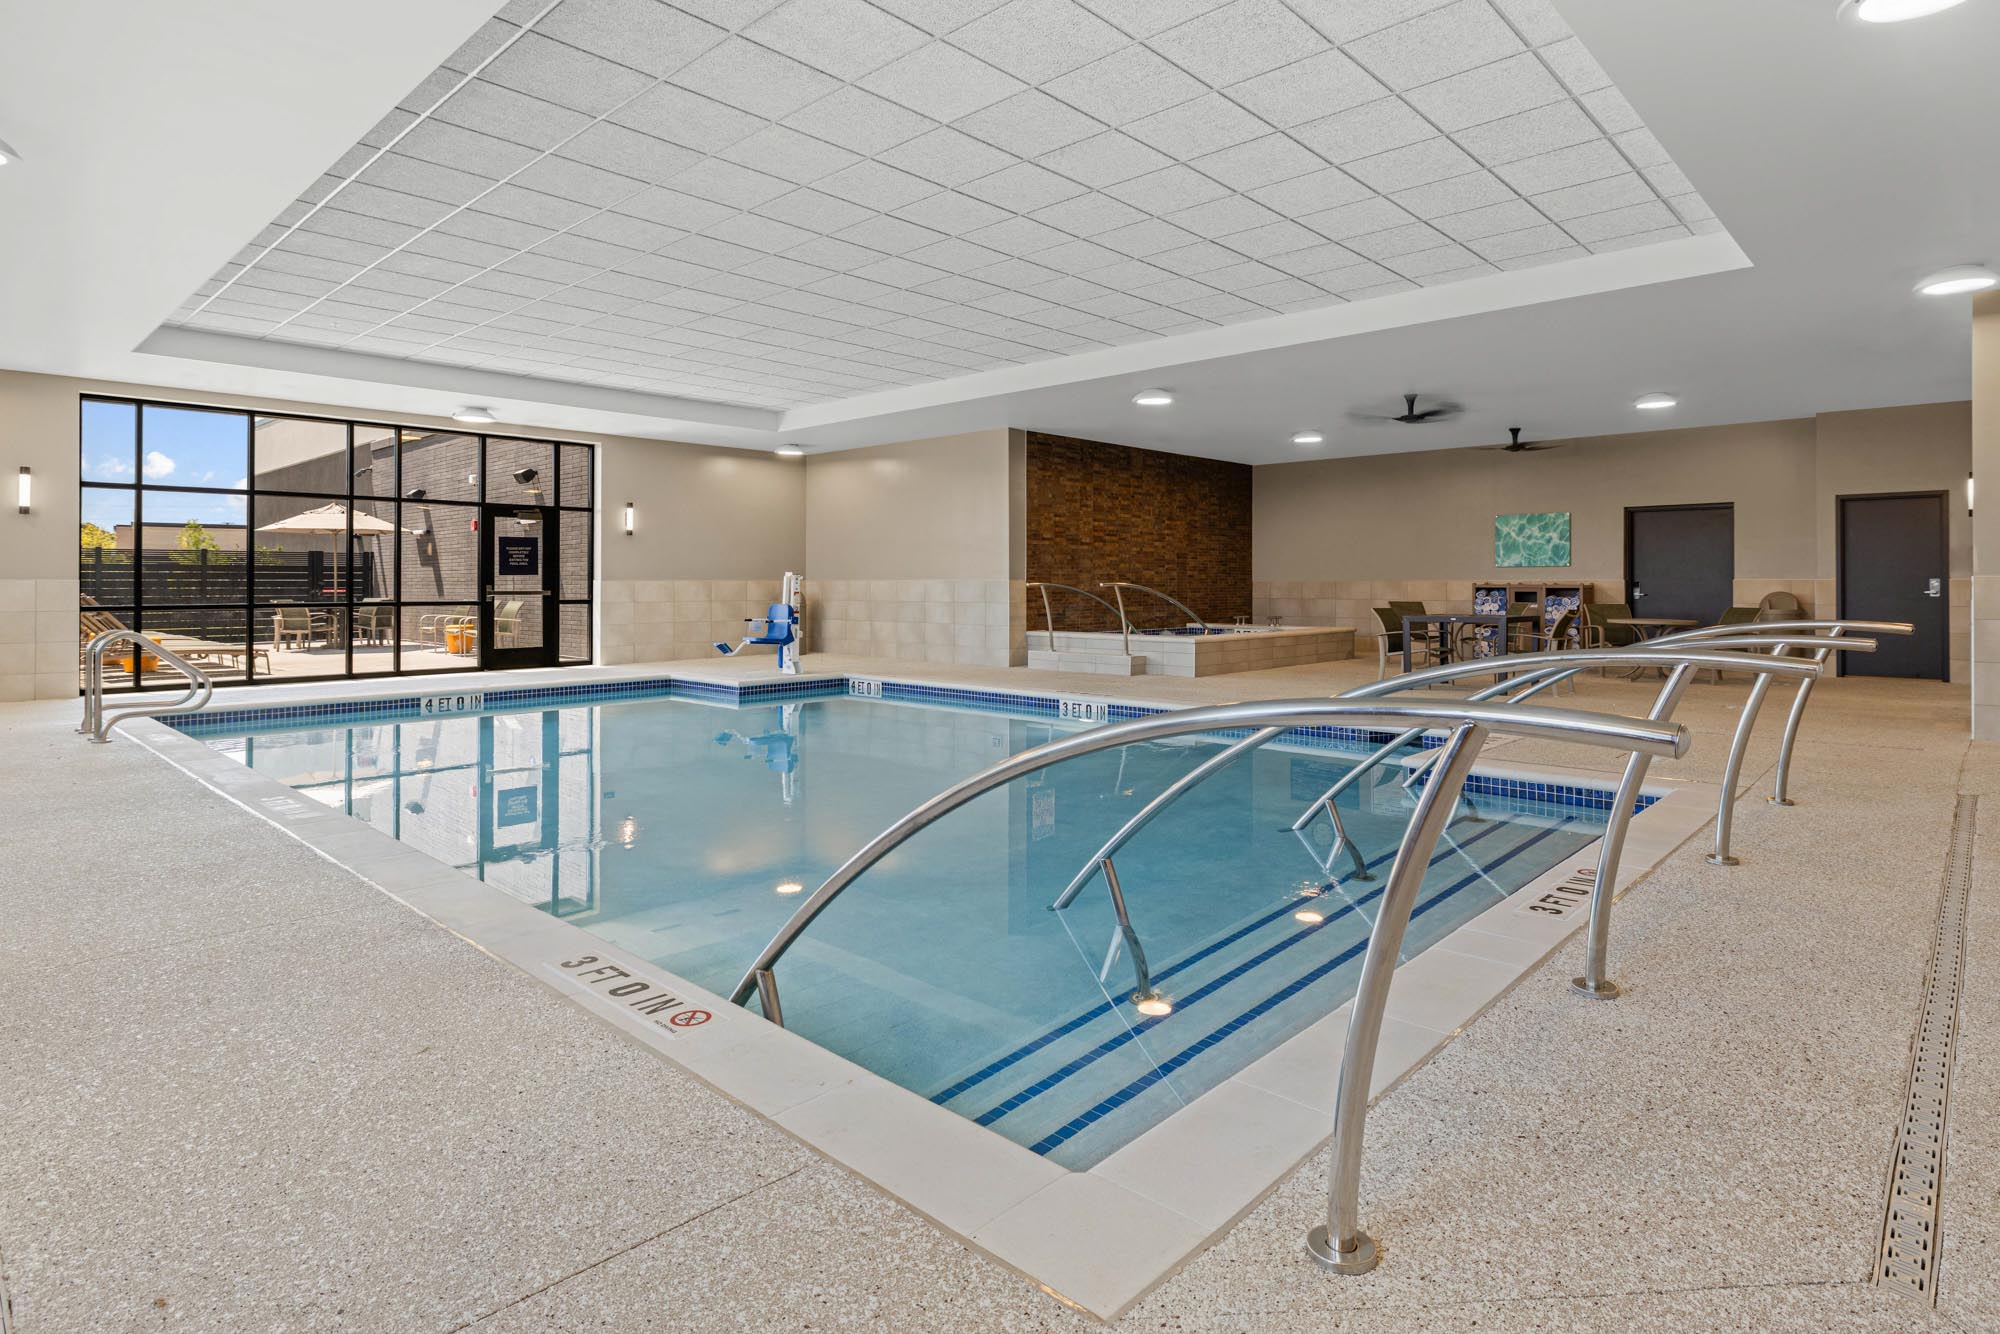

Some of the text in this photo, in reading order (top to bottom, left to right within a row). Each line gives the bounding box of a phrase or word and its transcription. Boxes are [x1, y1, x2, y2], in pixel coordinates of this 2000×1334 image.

[1539, 893, 1579, 908] FT
[1529, 905, 1564, 915] 3
[560, 955, 600, 969] 3
[577, 965, 631, 984] FT
[629, 993, 685, 1016] IN
